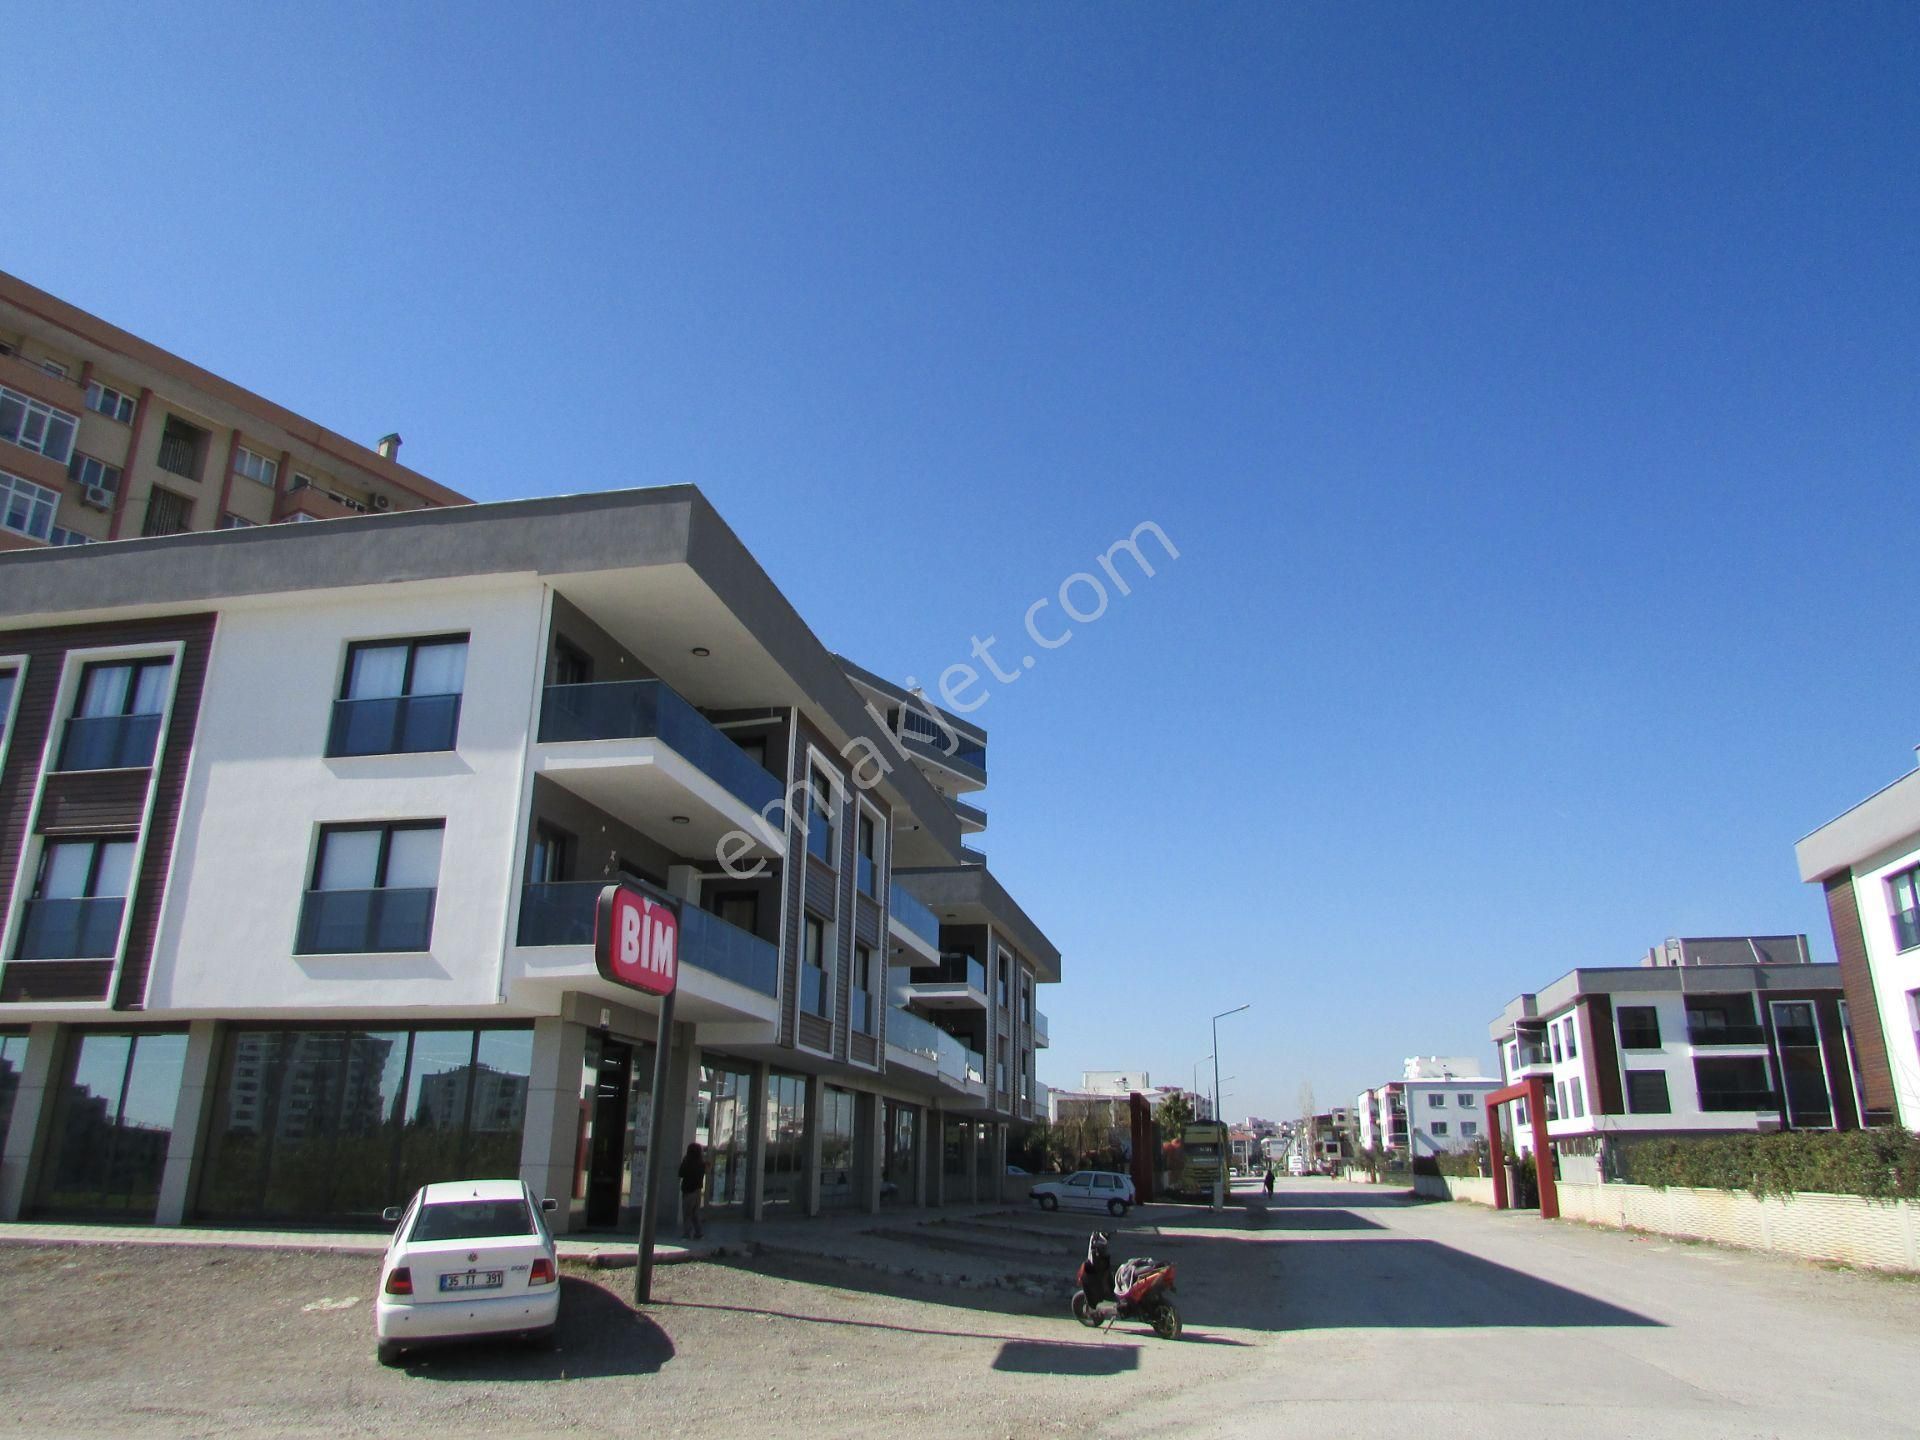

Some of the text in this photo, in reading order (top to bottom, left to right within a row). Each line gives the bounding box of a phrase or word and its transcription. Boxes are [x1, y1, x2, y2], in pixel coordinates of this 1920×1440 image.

[448, 1272, 501, 1286] 35 TT 391
